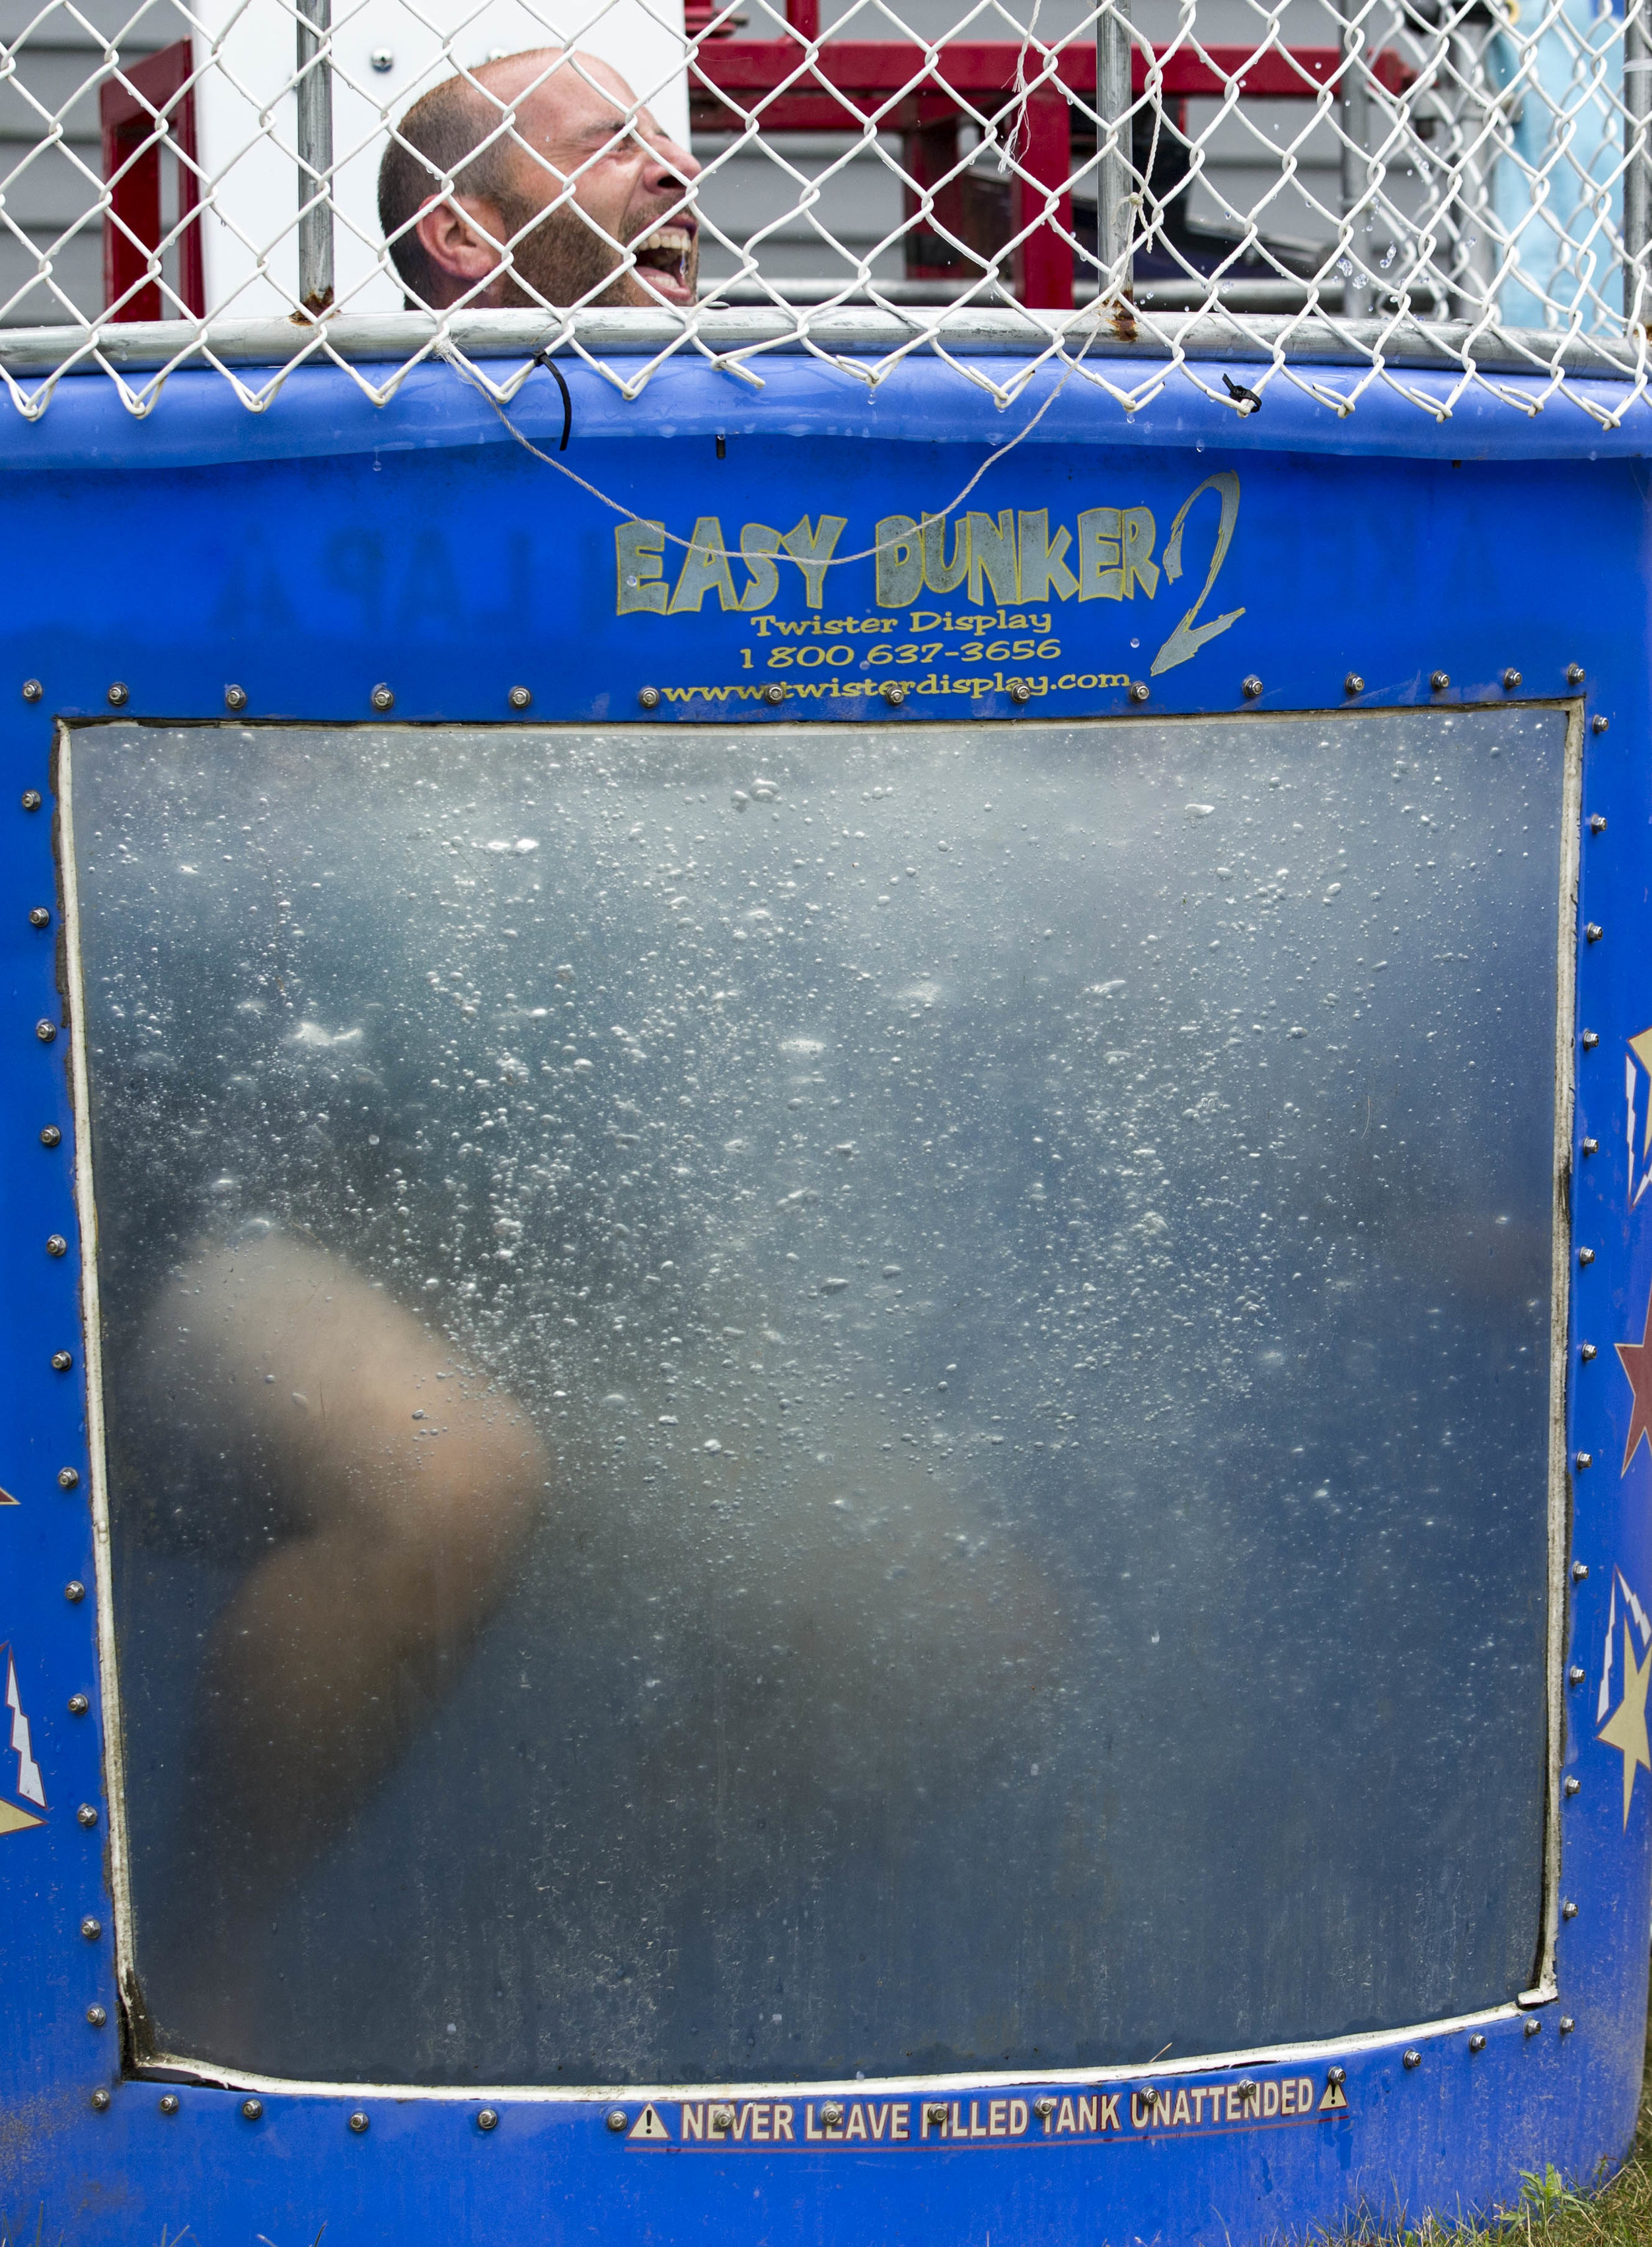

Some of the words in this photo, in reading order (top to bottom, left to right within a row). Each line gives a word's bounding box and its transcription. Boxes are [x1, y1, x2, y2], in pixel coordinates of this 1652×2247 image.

[615, 514, 848, 615] EASY
[875, 506, 1160, 608] DUNKER
[1150, 470, 1246, 676] 2
[751, 615, 897, 637] Twister
[909, 609, 1051, 636] Display
[739, 648, 754, 669] 1
[767, 645, 855, 668] 800
[866, 638, 1061, 665] 637-3656
[661, 672, 1131, 702] wwwtwisterdisplay.com
[682, 2102, 794, 2141] NEVER
[805, 2102, 911, 2140] LEAVE
[920, 2099, 1028, 2139] FILLED
[1035, 2094, 1122, 2133] TANK
[1131, 2078, 1314, 2129] UNATTENDED
